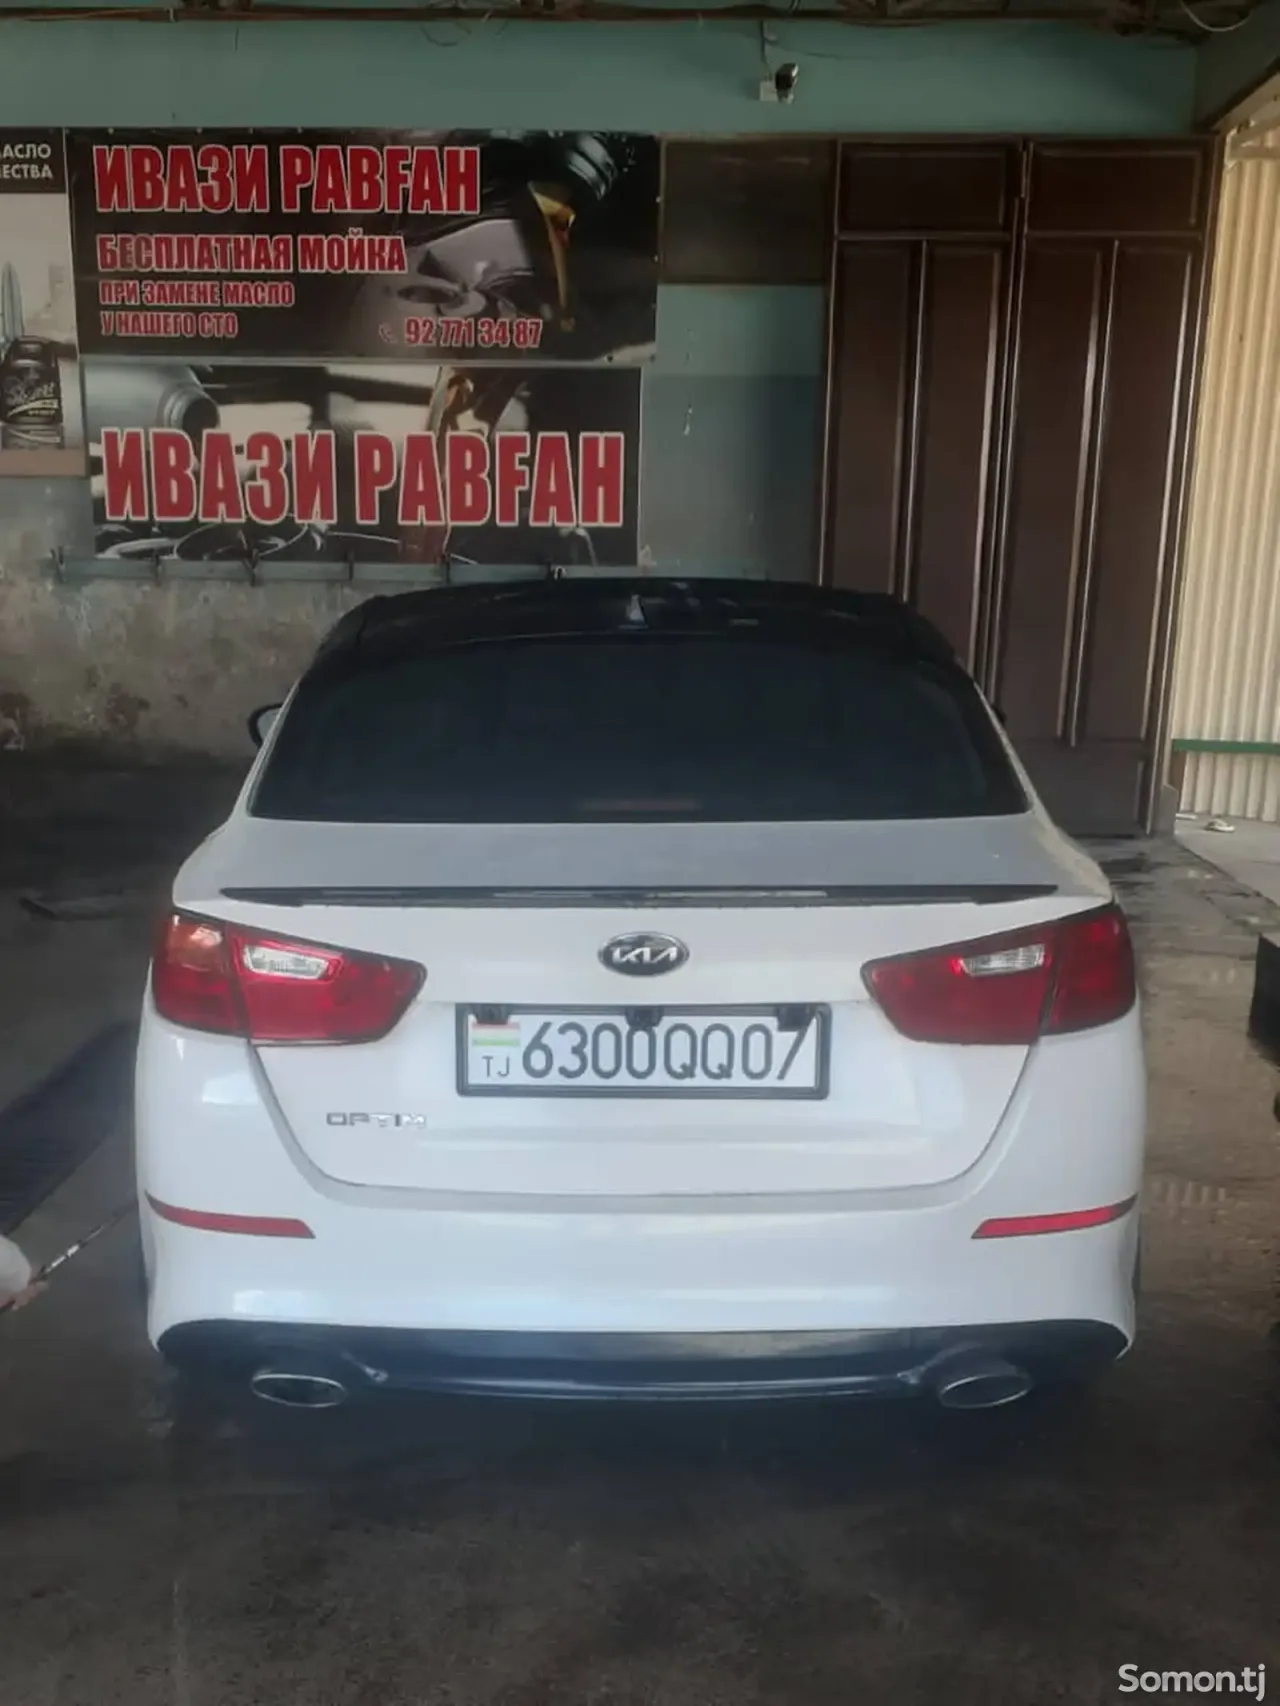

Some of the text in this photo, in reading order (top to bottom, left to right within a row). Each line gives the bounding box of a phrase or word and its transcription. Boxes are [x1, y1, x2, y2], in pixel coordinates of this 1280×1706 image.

[0, 143, 52, 159] АСЛО
[0, 163, 54, 180] ЕСТВА
[92, 144, 271, 213] ИВАЗИ
[96, 227, 409, 274] БЕСПЛАТНАЯ МОЙКА
[99, 279, 295, 308] ПРИ ЗАМЕНЕ МАСЛО
[100, 310, 239, 339] У НАШЕГО СТО
[404, 316, 544, 349] 92 771 34 87
[100, 427, 337, 525] ИВАЗИ
[481, 1020, 812, 1081] TJ 6300QQ07
